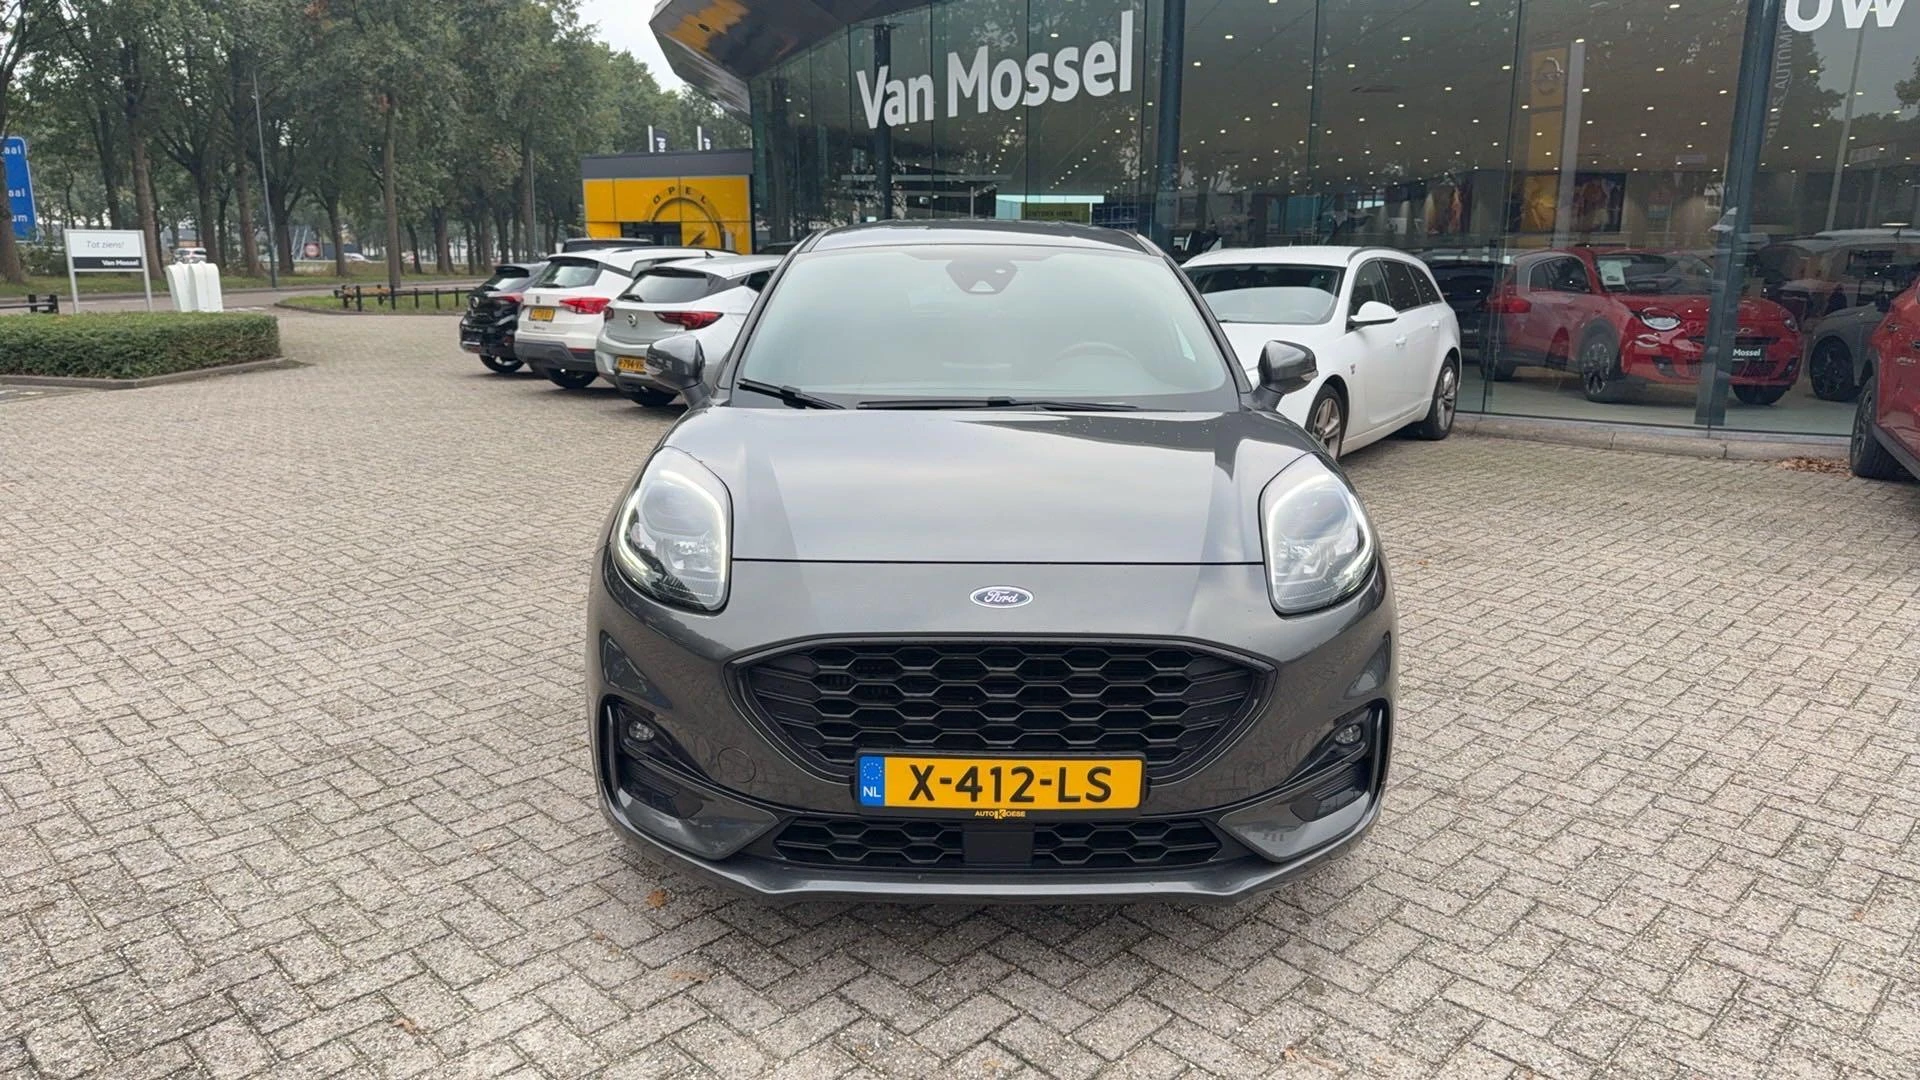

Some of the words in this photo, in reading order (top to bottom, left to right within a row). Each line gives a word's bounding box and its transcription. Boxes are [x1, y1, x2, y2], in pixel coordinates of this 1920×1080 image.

[856, 65, 934, 129] Van
[947, 9, 1134, 118] Mossel
[653, 186, 707, 205] OPEL
[87, 240, 101, 249] Tot
[1732, 348, 1761, 357] Mossel
[984, 590, 1019, 603] Ford
[908, 764, 1113, 804] X-412-LS
[863, 786, 881, 799] NL
